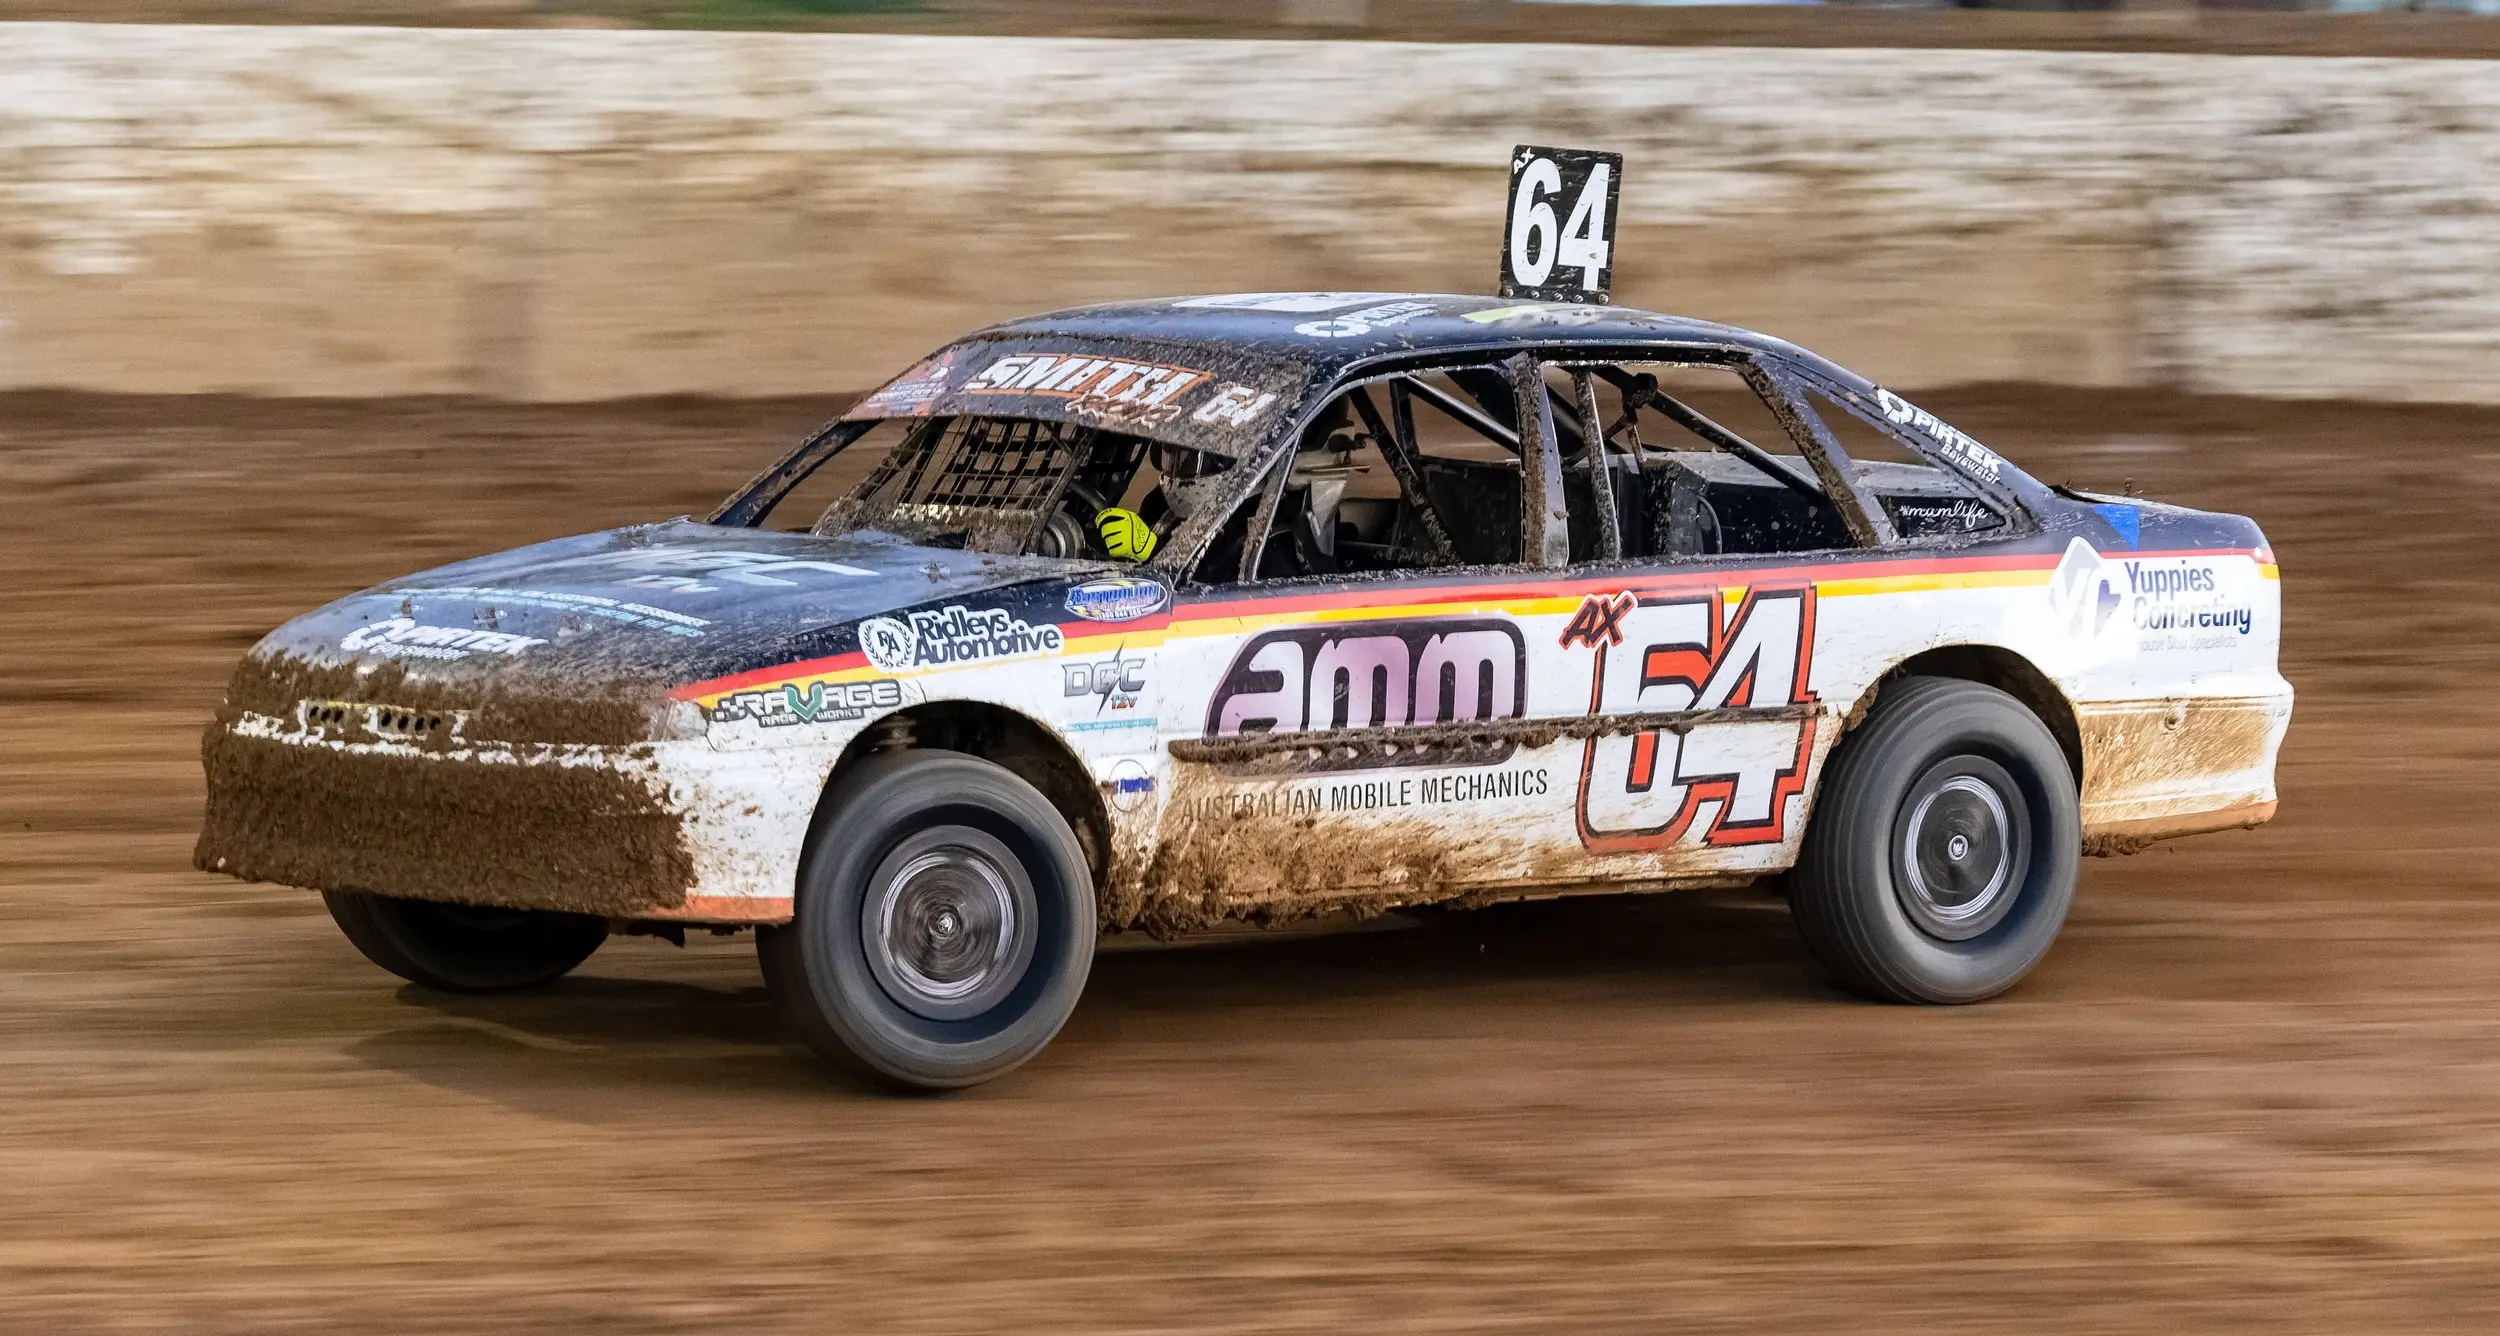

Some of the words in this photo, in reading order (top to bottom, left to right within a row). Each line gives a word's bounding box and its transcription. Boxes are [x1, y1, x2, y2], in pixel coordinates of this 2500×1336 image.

[1510, 157, 1611, 291] 64
[962, 353, 1200, 405] SMITH
[1913, 412, 2003, 473] PIRTEK
[2124, 559, 2216, 601] Yuppies
[913, 609, 1009, 641] Ridleys
[1562, 595, 1637, 647] AX
[2132, 594, 2252, 635] Concreting
[912, 624, 1060, 667] Automotive
[734, 683, 900, 720] RAVAGE
[1578, 586, 1816, 848] 64
[1331, 780, 1412, 812] MOBILE
[1421, 768, 1549, 804] MECHANICS
